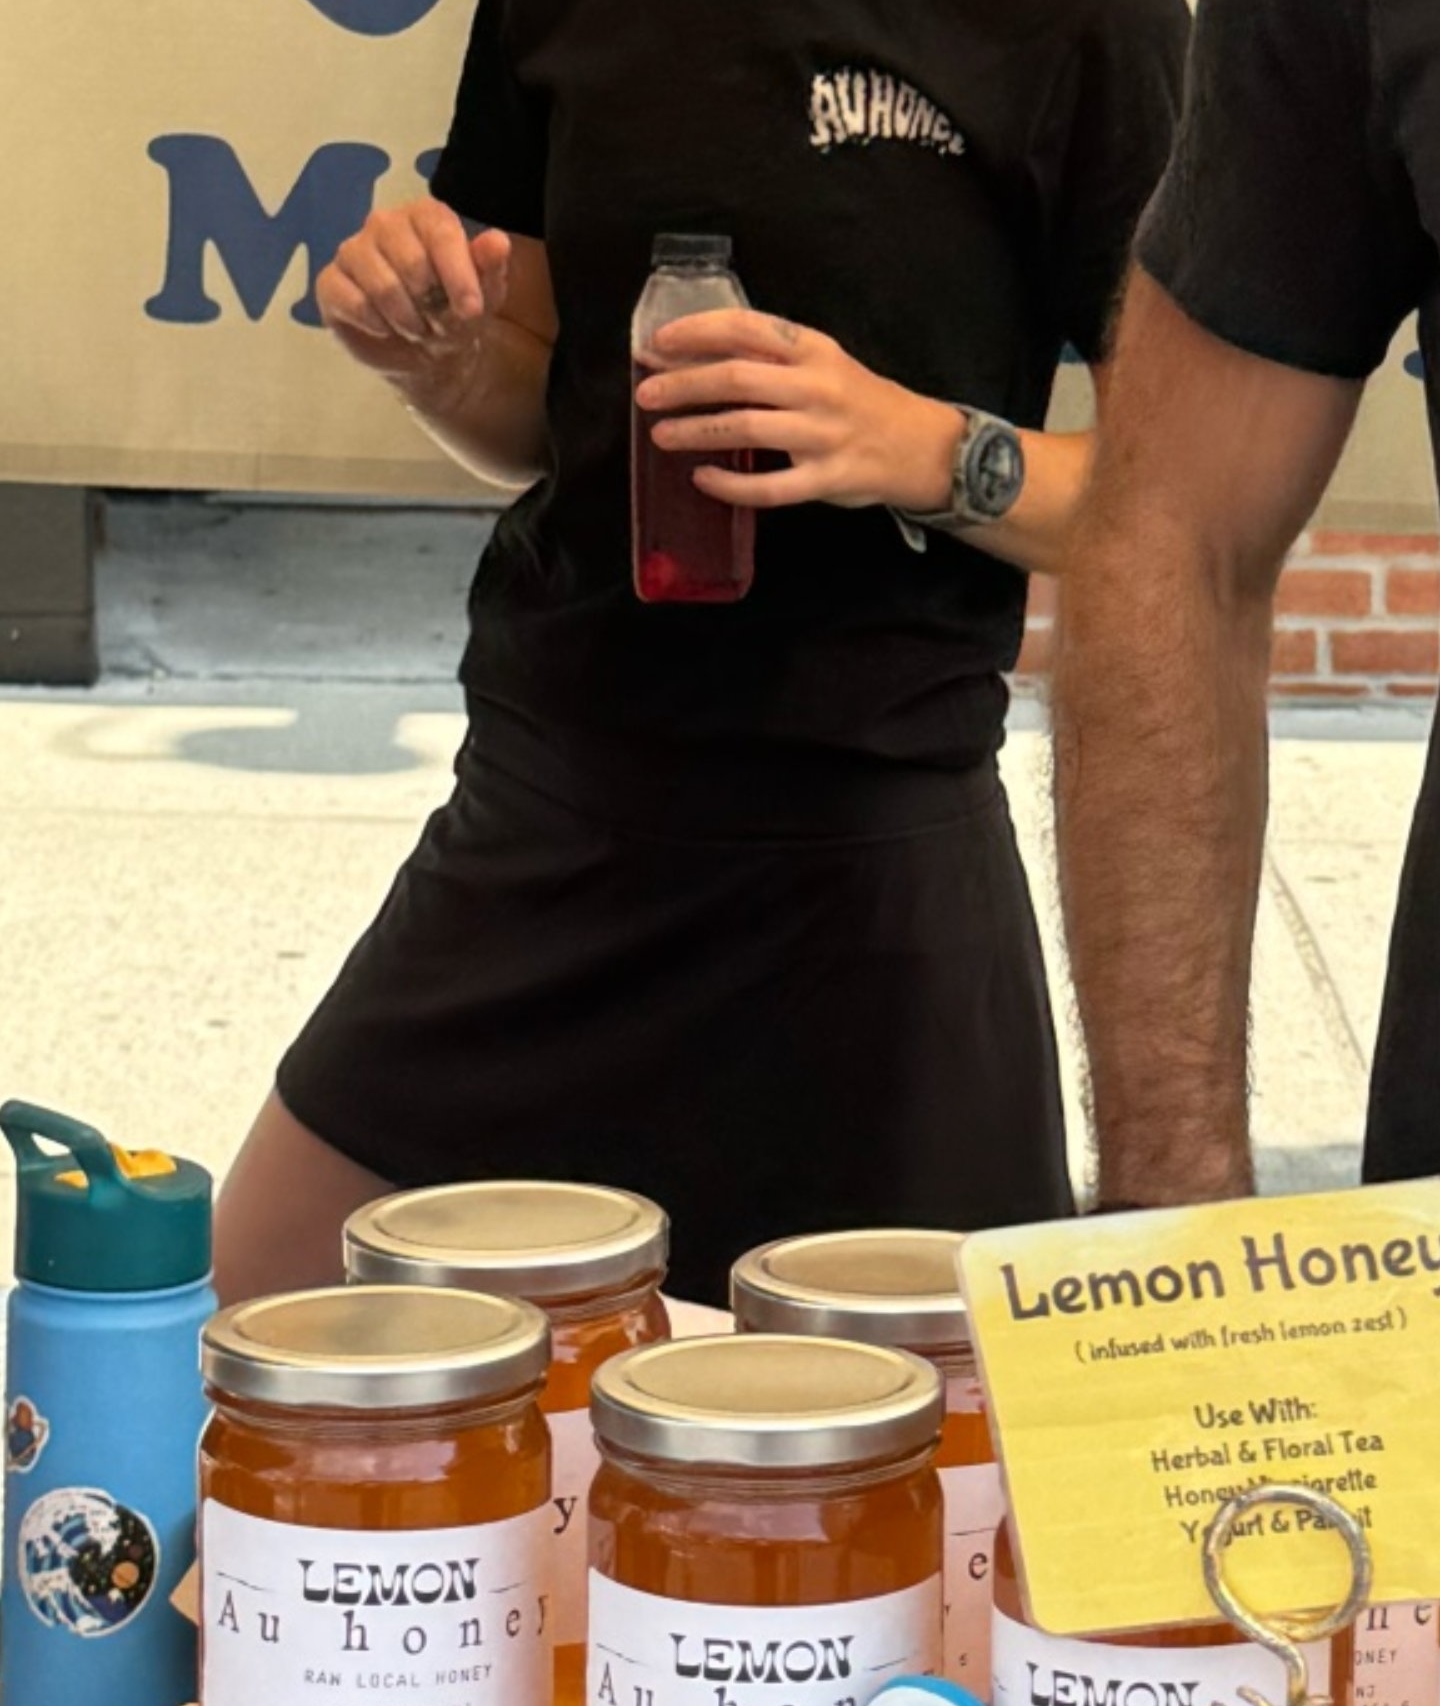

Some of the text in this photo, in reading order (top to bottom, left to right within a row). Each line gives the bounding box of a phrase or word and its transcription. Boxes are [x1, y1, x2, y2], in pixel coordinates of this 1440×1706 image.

[1000, 1257, 1225, 1322] Lemon
[1170, 1328, 1217, 1351] with
[1221, 1323, 1275, 1348] fresh
[1280, 1319, 1347, 1342] lemon
[1193, 1396, 1318, 1429] Use With:
[1150, 1430, 1384, 1473] Herbal & Floral Tea
[1270, 1510, 1289, 1533] &
[298, 1558, 480, 1606] LEMON
[218, 1591, 280, 1643] Au
[304, 1664, 493, 1689] RAW LOCAL HONEY
[669, 1632, 854, 1683] LEMON
